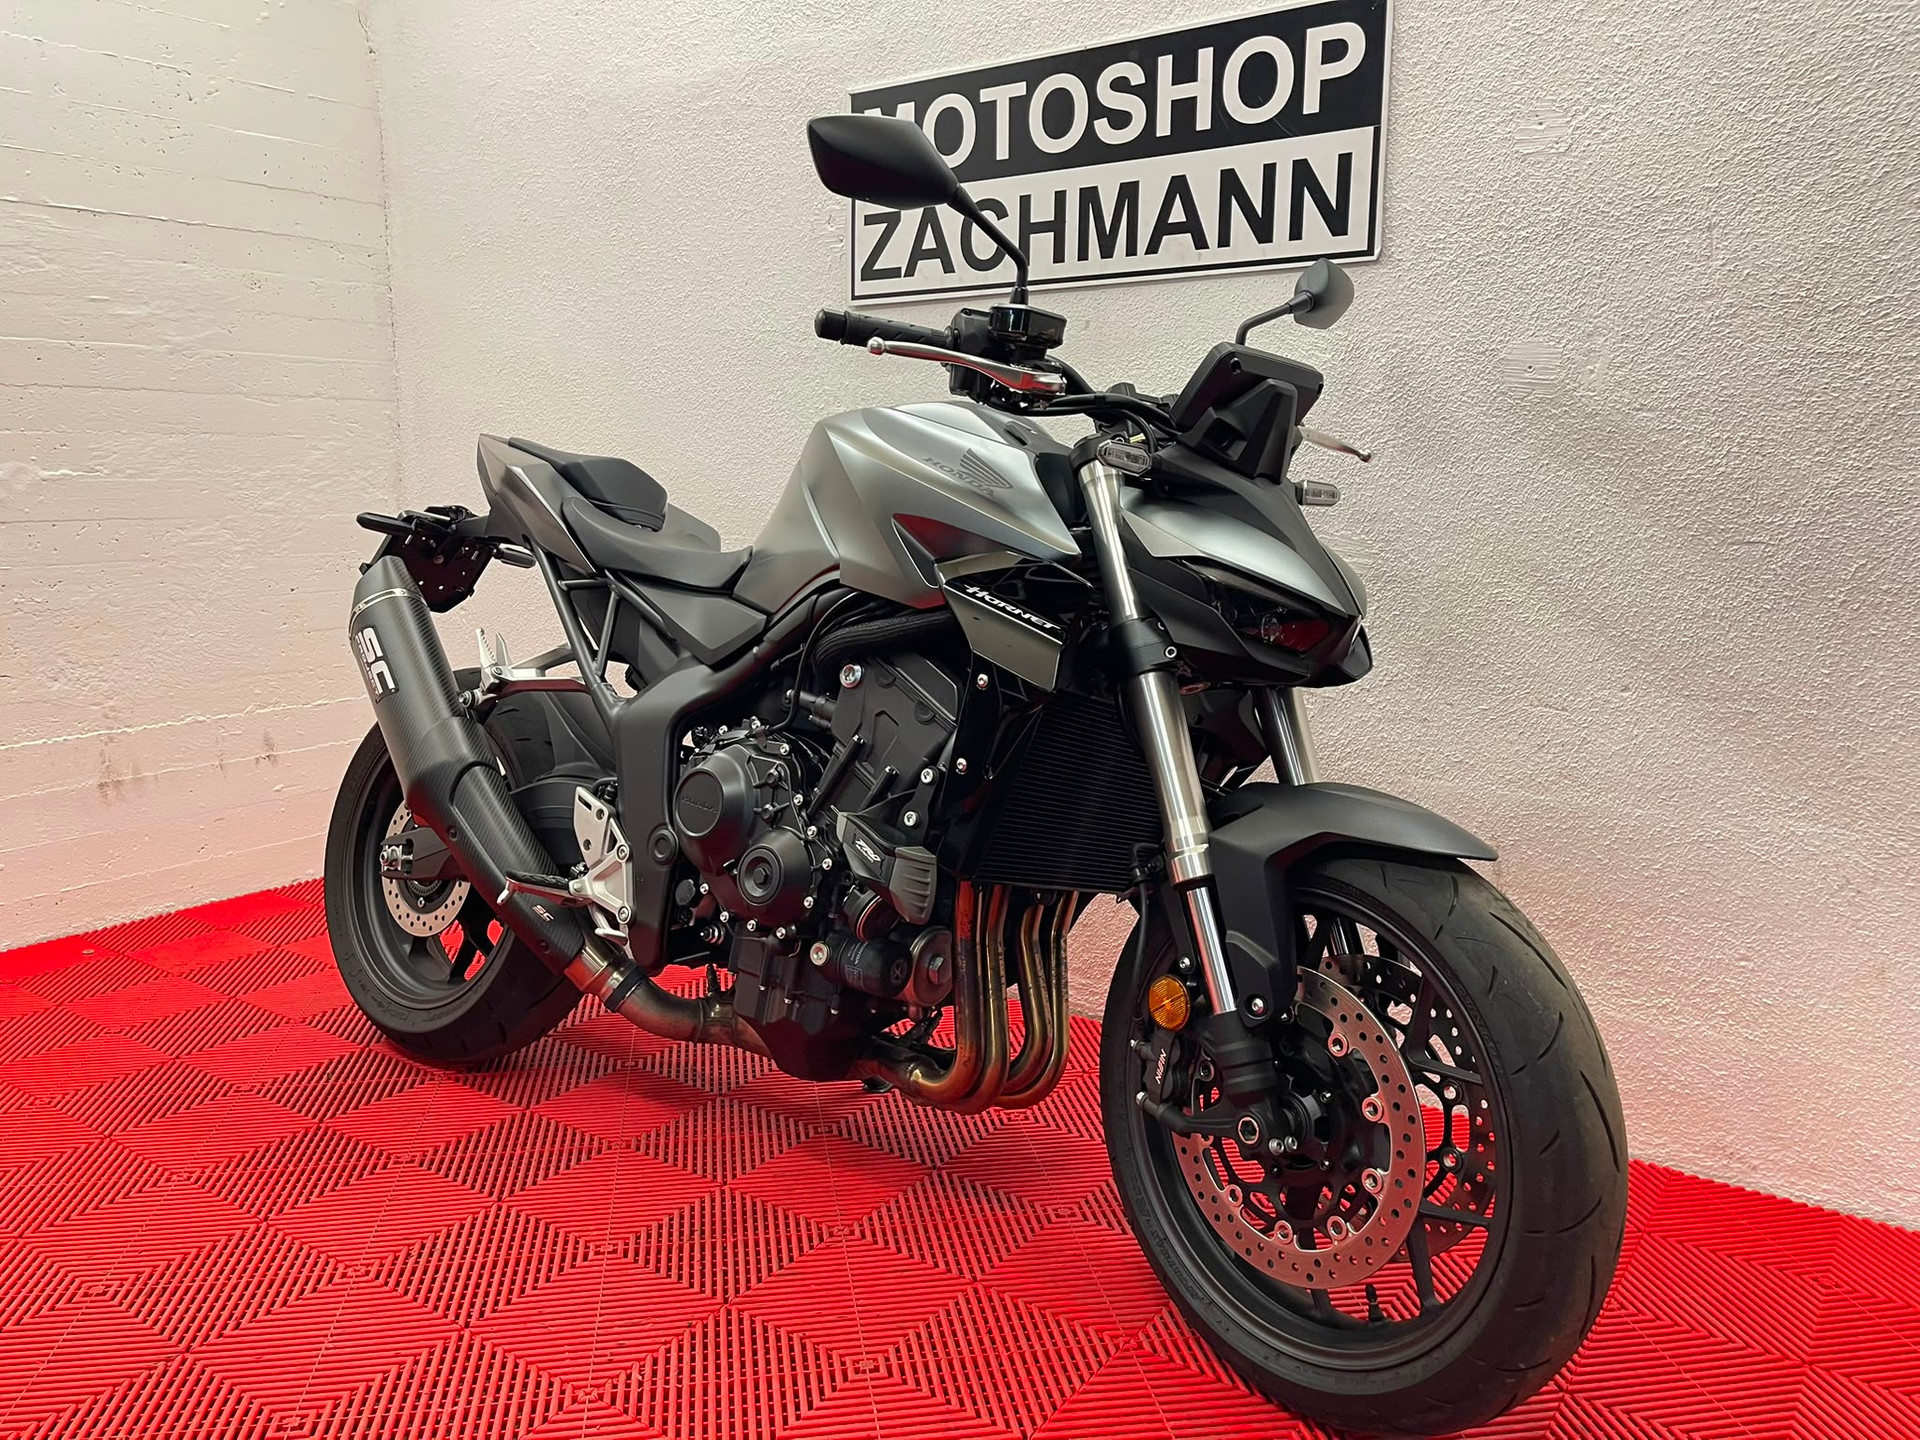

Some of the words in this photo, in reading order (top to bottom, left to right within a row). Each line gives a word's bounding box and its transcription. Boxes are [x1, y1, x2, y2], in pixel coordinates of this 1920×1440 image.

[864, 22, 1366, 169] OTOSHOP
[860, 152, 1353, 281] ZACHMANN
[921, 457, 994, 497] HONDA
[357, 627, 396, 694] SC
